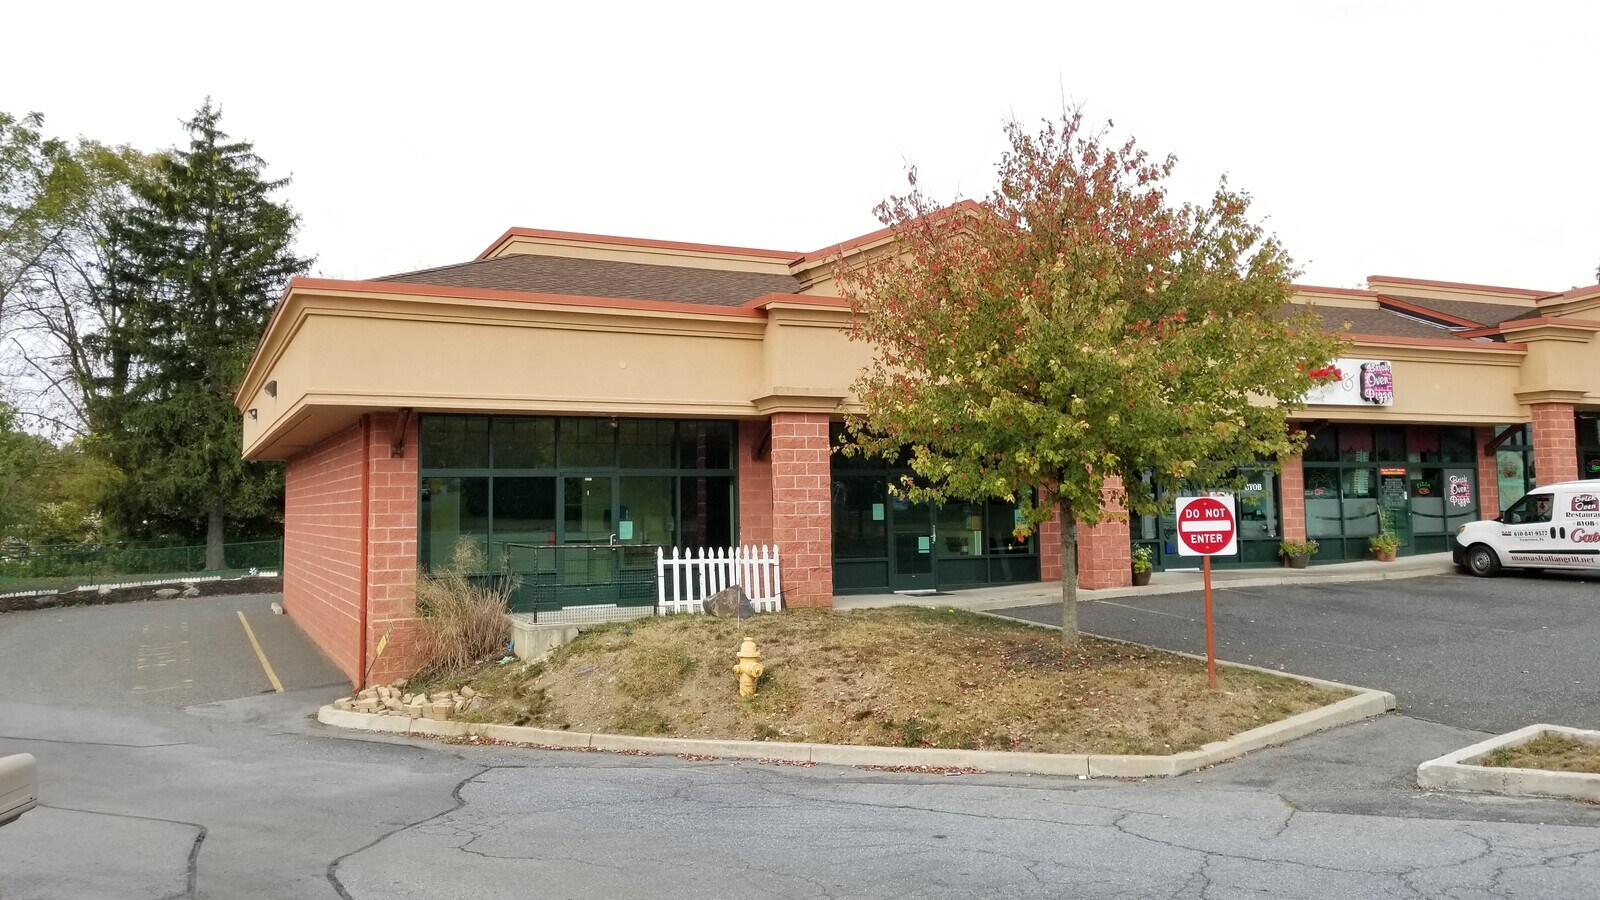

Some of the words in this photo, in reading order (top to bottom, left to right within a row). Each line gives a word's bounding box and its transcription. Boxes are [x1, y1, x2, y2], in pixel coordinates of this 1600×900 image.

[1365, 361, 1391, 373] Brick
[1367, 373, 1389, 386] Oven
[1364, 388, 1394, 404] Pizza
[1575, 495, 1597, 503] Brick
[1575, 502, 1596, 511] Oven
[1185, 509, 1200, 519] DO
[1205, 508, 1226, 518] NOT
[1190, 533, 1223, 544] ENTER
